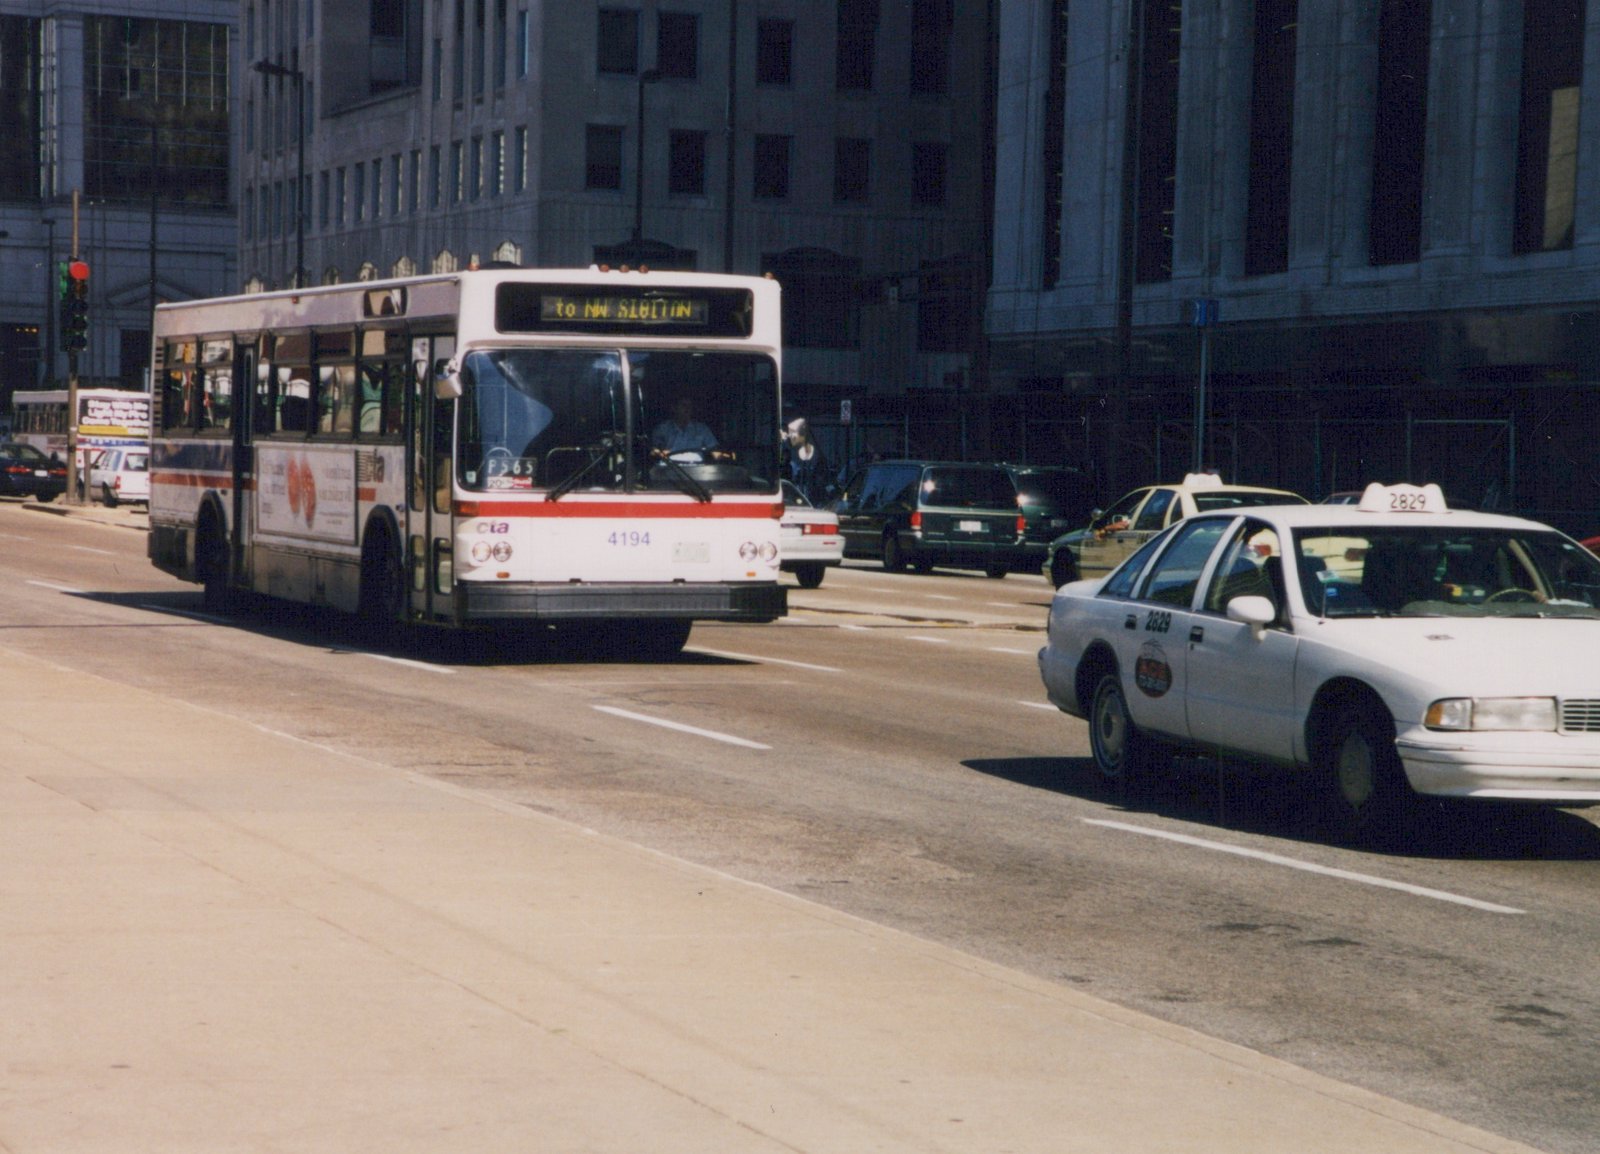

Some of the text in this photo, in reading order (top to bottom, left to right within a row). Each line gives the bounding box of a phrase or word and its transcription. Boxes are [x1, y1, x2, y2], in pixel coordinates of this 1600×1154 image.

[556, 299, 576, 317] to
[1390, 493, 1426, 510] 2829
[608, 531, 650, 546] 4194
[1145, 610, 1172, 633] 2829
